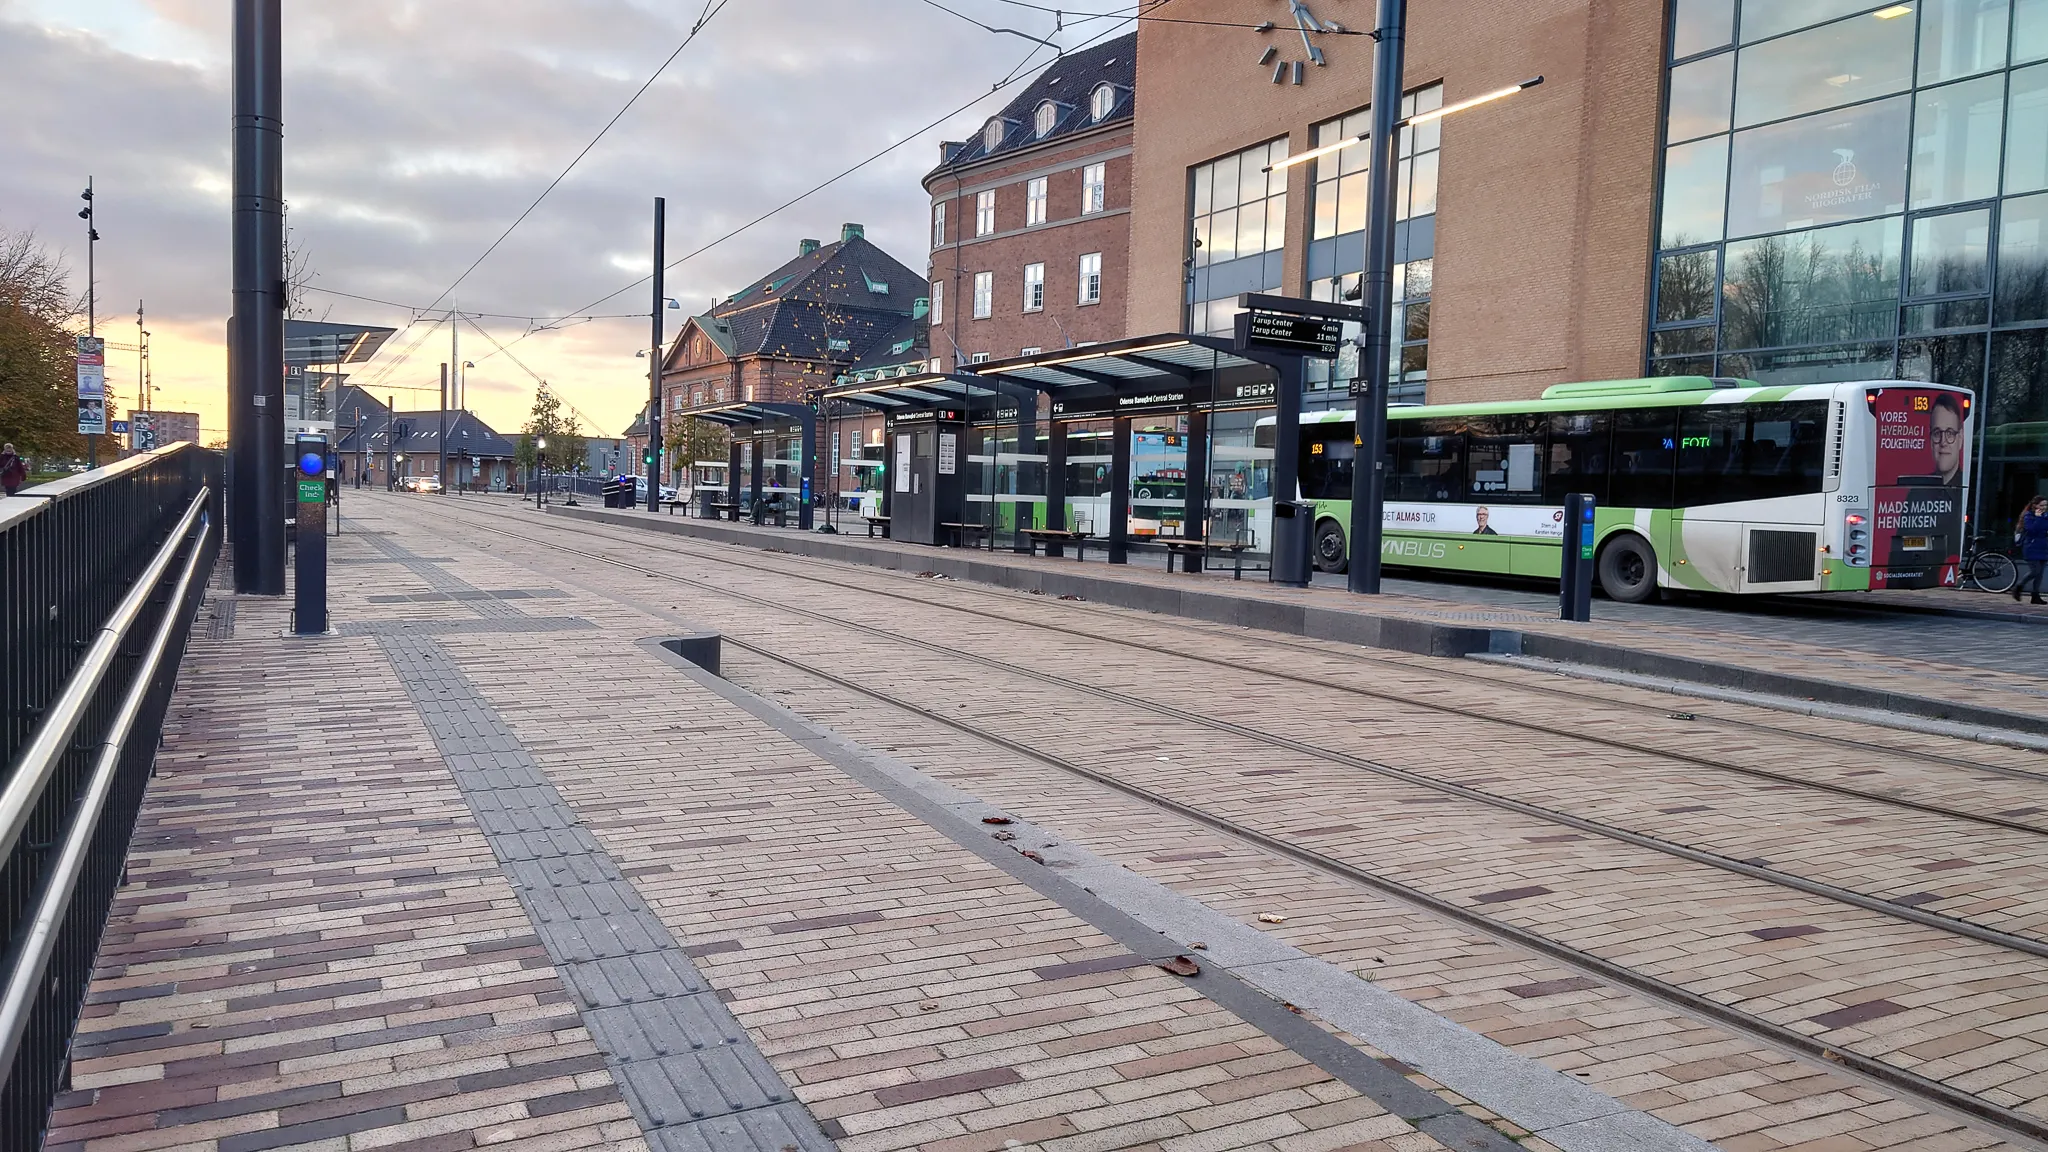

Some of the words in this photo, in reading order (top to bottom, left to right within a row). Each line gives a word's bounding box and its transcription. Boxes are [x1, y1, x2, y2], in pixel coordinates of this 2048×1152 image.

[1804, 187, 1852, 202] NORDISK
[1812, 191, 1872, 209] BIOGRAFER
[1272, 318, 1293, 327] Center
[1271, 327, 1292, 337] Center
[1321, 324, 1326, 332] 4
[1327, 325, 1338, 333] min
[1316, 333, 1325, 341] 11
[1325, 334, 1337, 342] min
[1119, 397, 1134, 406] Odense
[1134, 395, 1152, 404] Banegård
[1153, 394, 1168, 403] Central
[1168, 393, 1184, 402] Station
[1914, 396, 1929, 411] 153
[1880, 411, 1908, 423] VORES
[1880, 425, 1919, 436] HVERDAG
[1920, 425, 1924, 436] I
[1167, 436, 1175, 445] 55
[1880, 438, 1925, 449] FOLKETINGET
[1311, 443, 1323, 454] 153
[1836, 495, 1859, 503] 8323
[1878, 501, 1909, 514] MADS
[1910, 500, 1952, 513] MADSEN
[1396, 511, 1421, 522] ALMAS
[1422, 512, 1436, 523] TUR
[1877, 515, 1937, 529] HENRIKSEN
[1944, 565, 1955, 584] A
